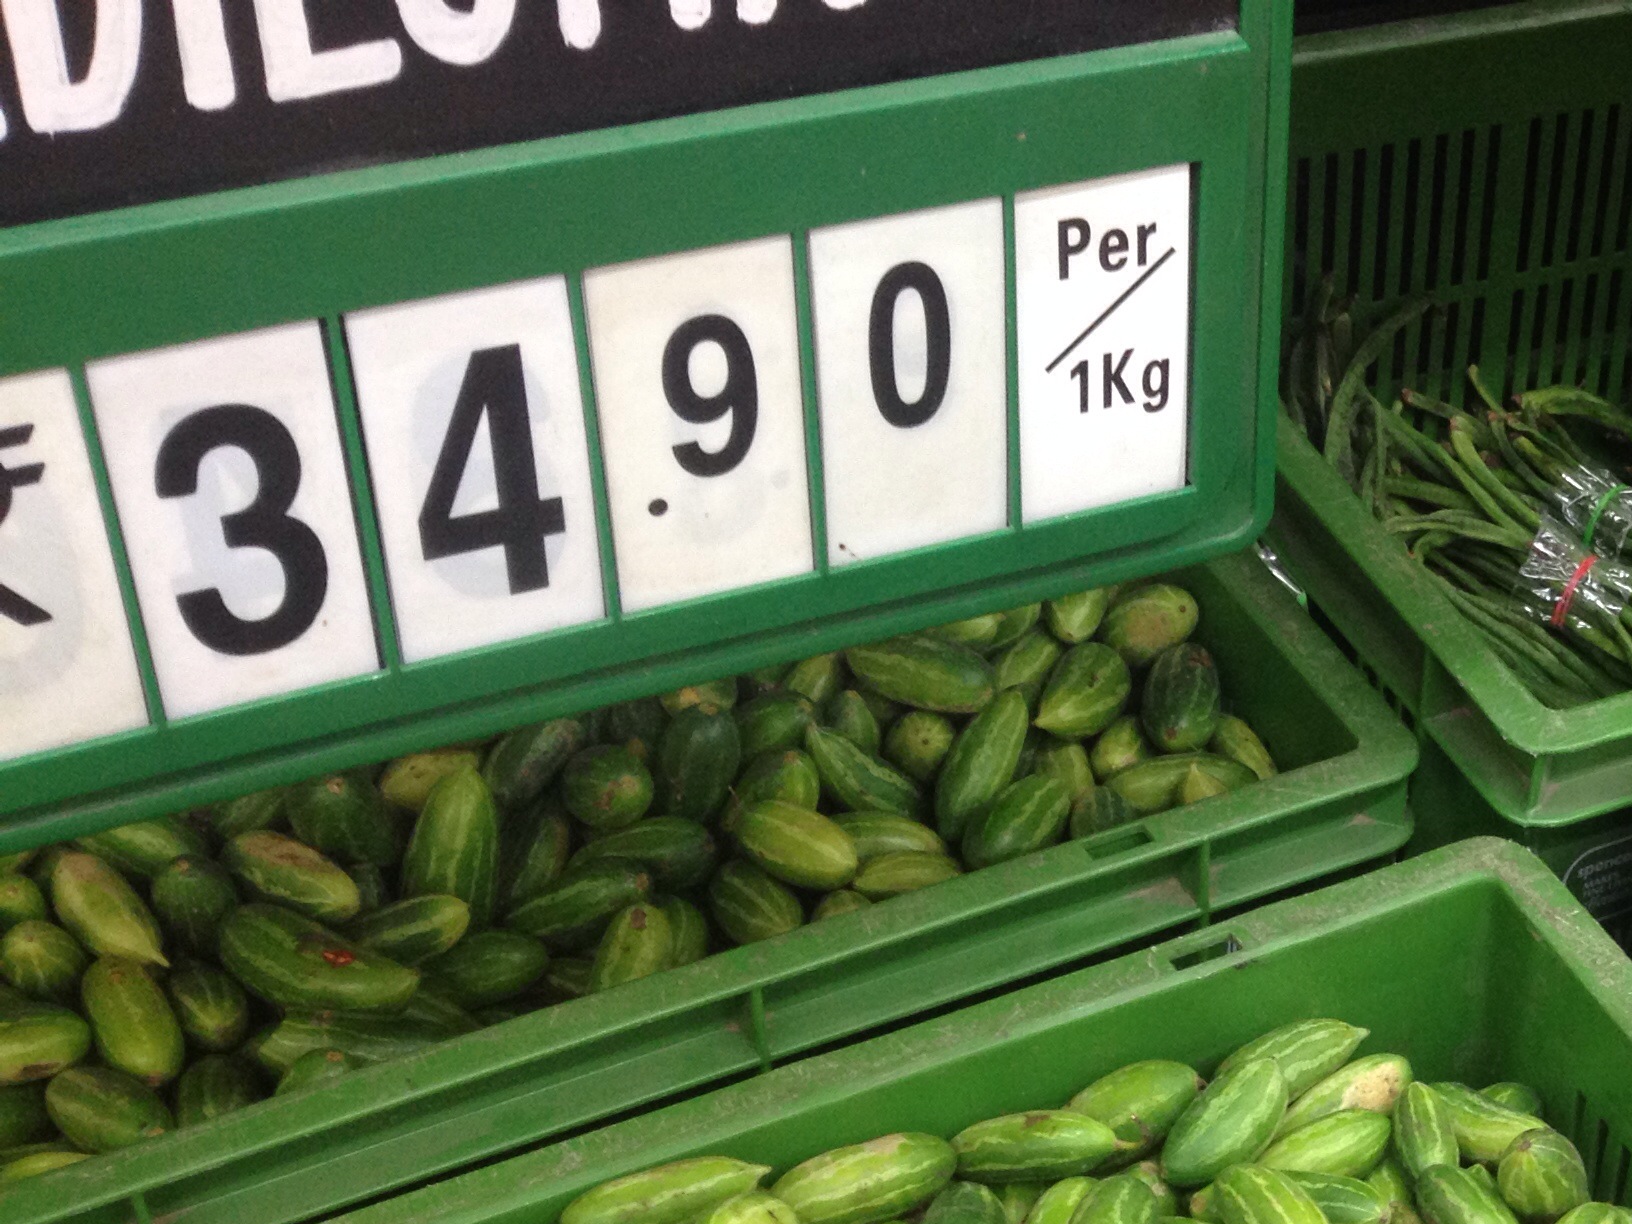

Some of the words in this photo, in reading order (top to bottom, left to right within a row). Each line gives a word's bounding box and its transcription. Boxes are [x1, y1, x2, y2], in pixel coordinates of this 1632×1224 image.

[1057, 217, 1157, 280] Per
[1070, 348, 1170, 414] 1Kg
[154, 260, 952, 656] 34.90
